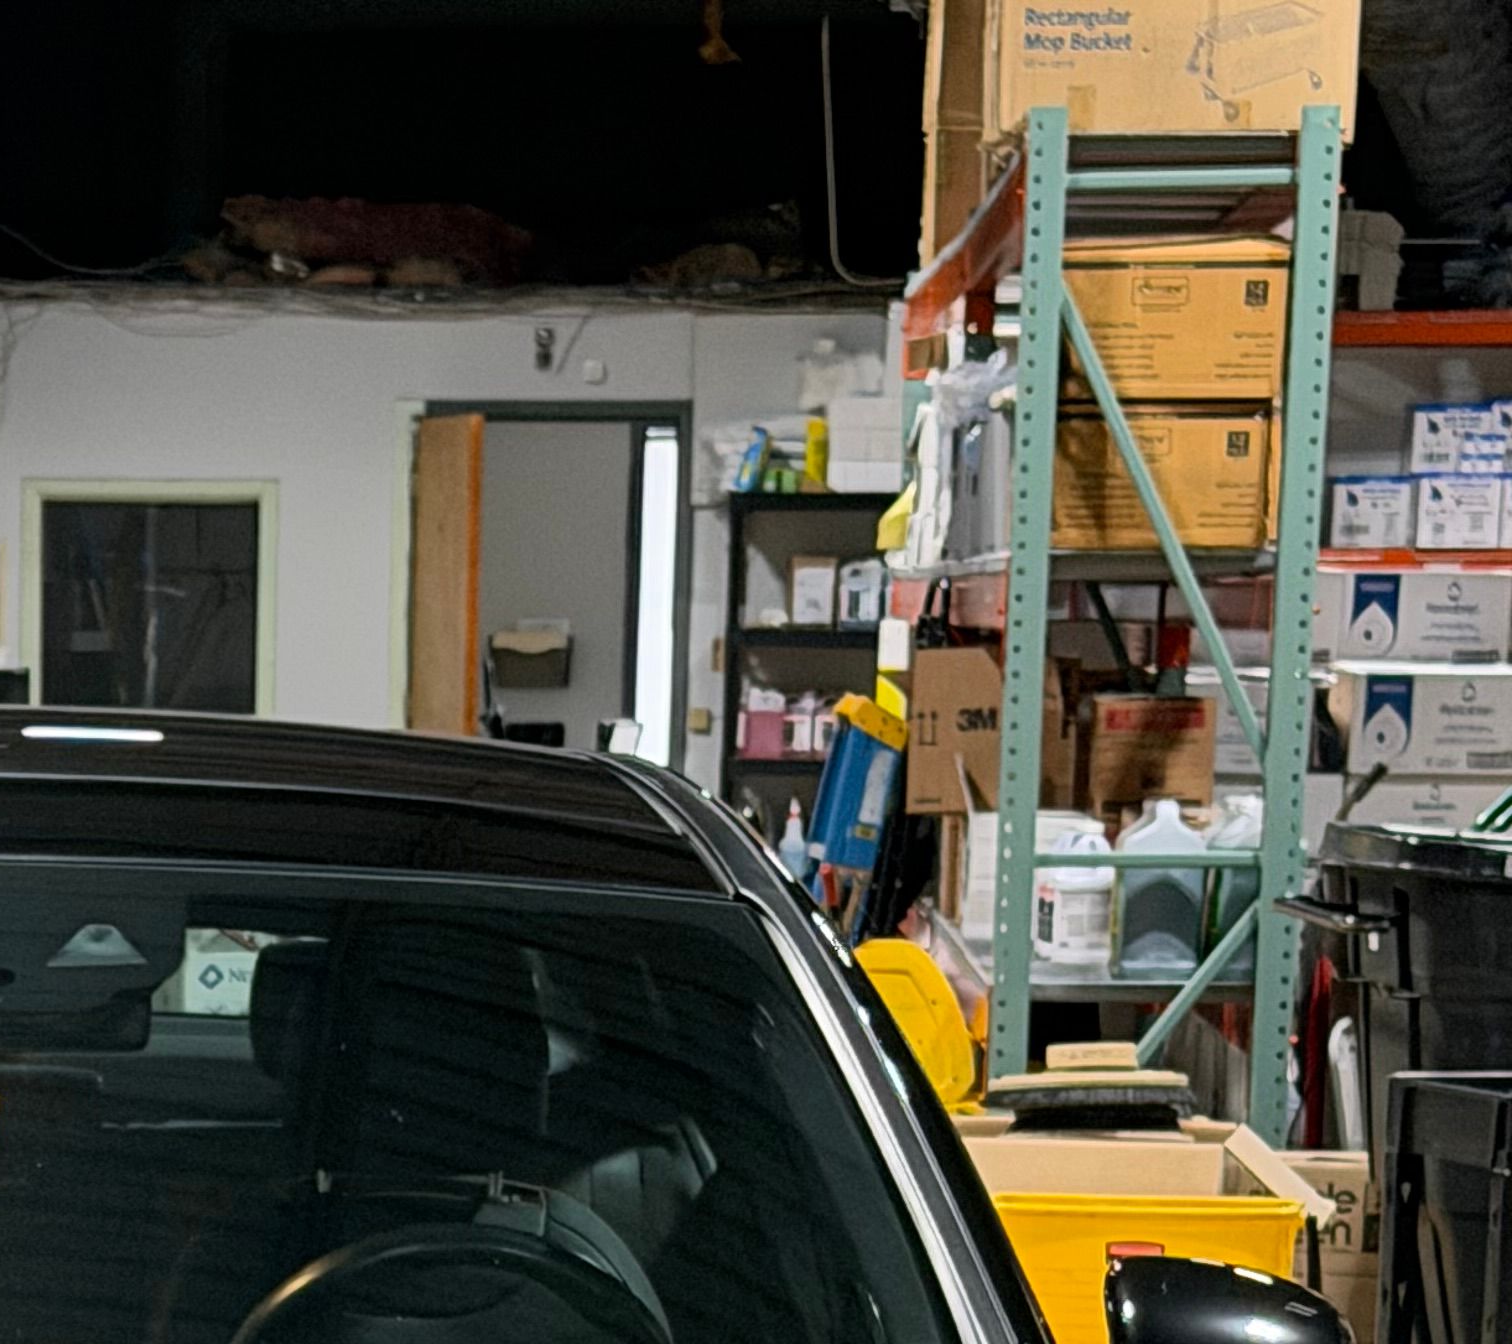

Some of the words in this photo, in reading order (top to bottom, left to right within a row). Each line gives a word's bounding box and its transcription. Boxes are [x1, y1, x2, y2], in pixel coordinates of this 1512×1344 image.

[1024, 7, 1131, 31] Rectangular
[1024, 32, 1065, 54] Mop
[1070, 32, 1132, 50] Bucket
[956, 707, 998, 732] 3M
